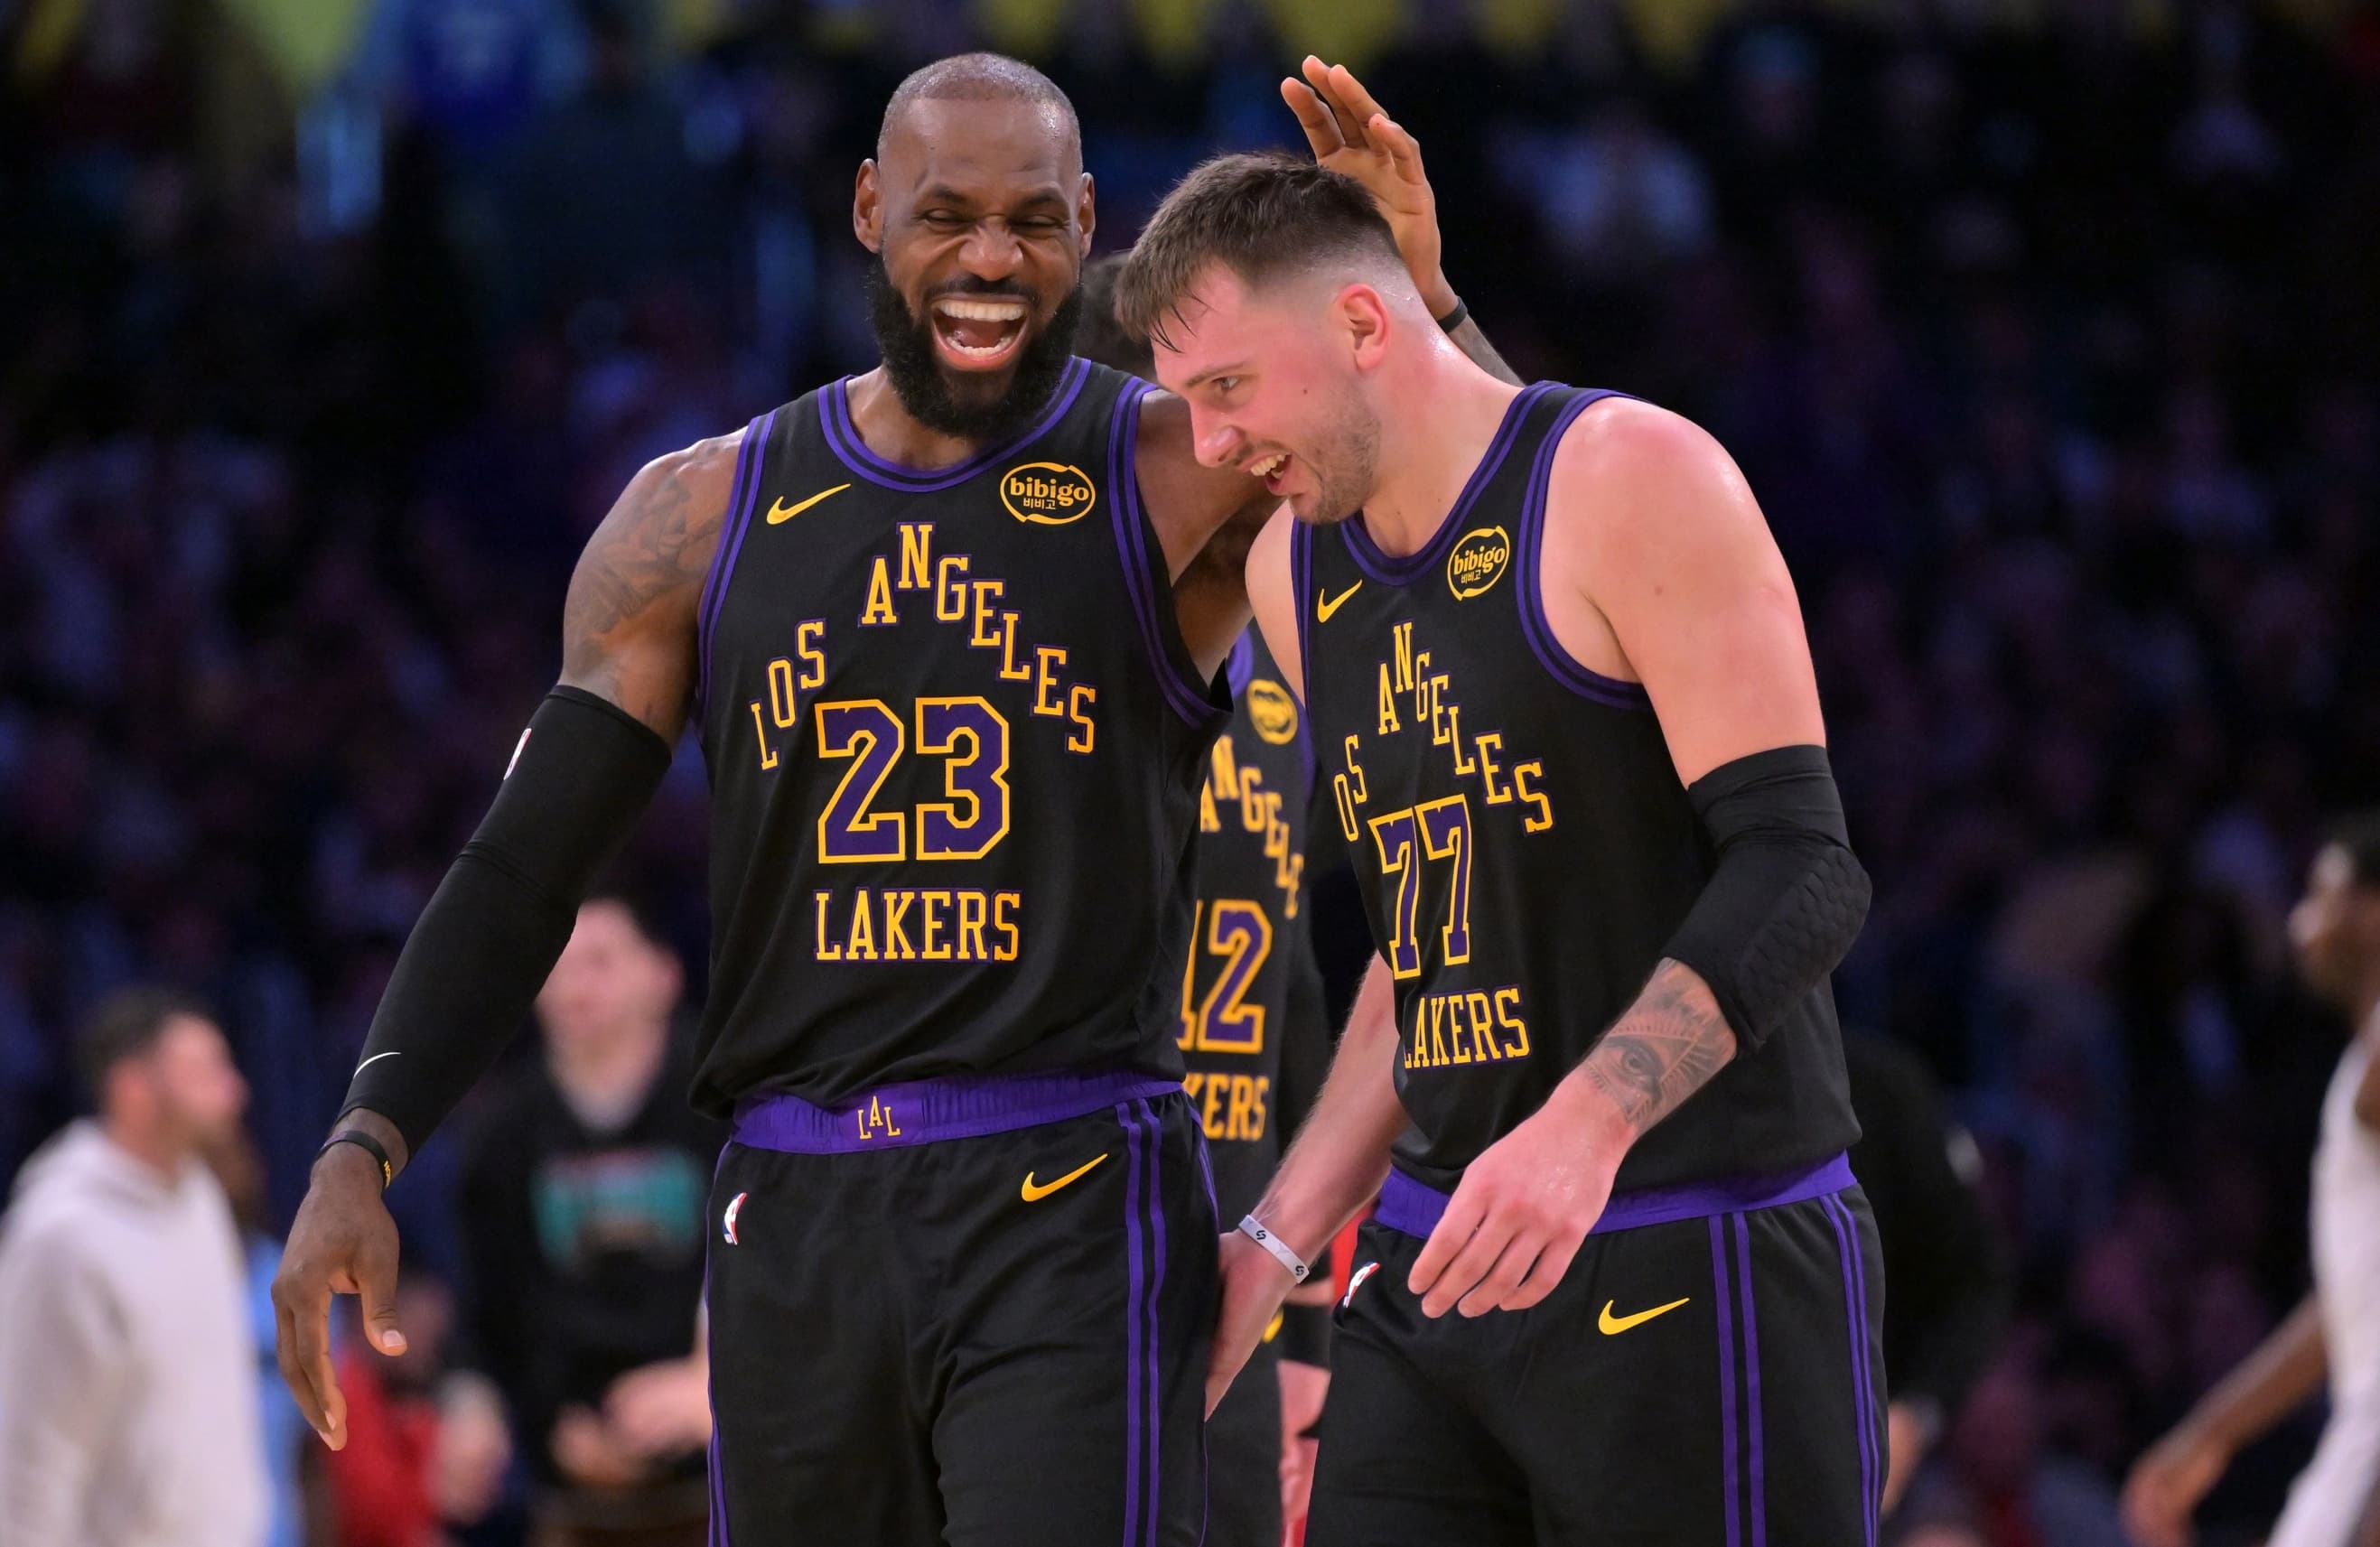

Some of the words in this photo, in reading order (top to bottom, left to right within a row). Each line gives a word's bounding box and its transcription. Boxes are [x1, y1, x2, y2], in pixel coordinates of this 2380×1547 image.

[1010, 476, 1089, 507] bibigo
[1022, 498, 1057, 510] 비비고
[1453, 545, 1506, 574] bibigo
[750, 620, 826, 771] LOS
[859, 522, 1097, 754] ANGELES
[1333, 733, 1368, 843] OS
[1377, 620, 1554, 834] ANGELES
[814, 695, 1011, 864] 23
[1367, 793, 1473, 982] 77
[815, 888, 1022, 963] LAKERS
[857, 1095, 901, 1141] LAL
